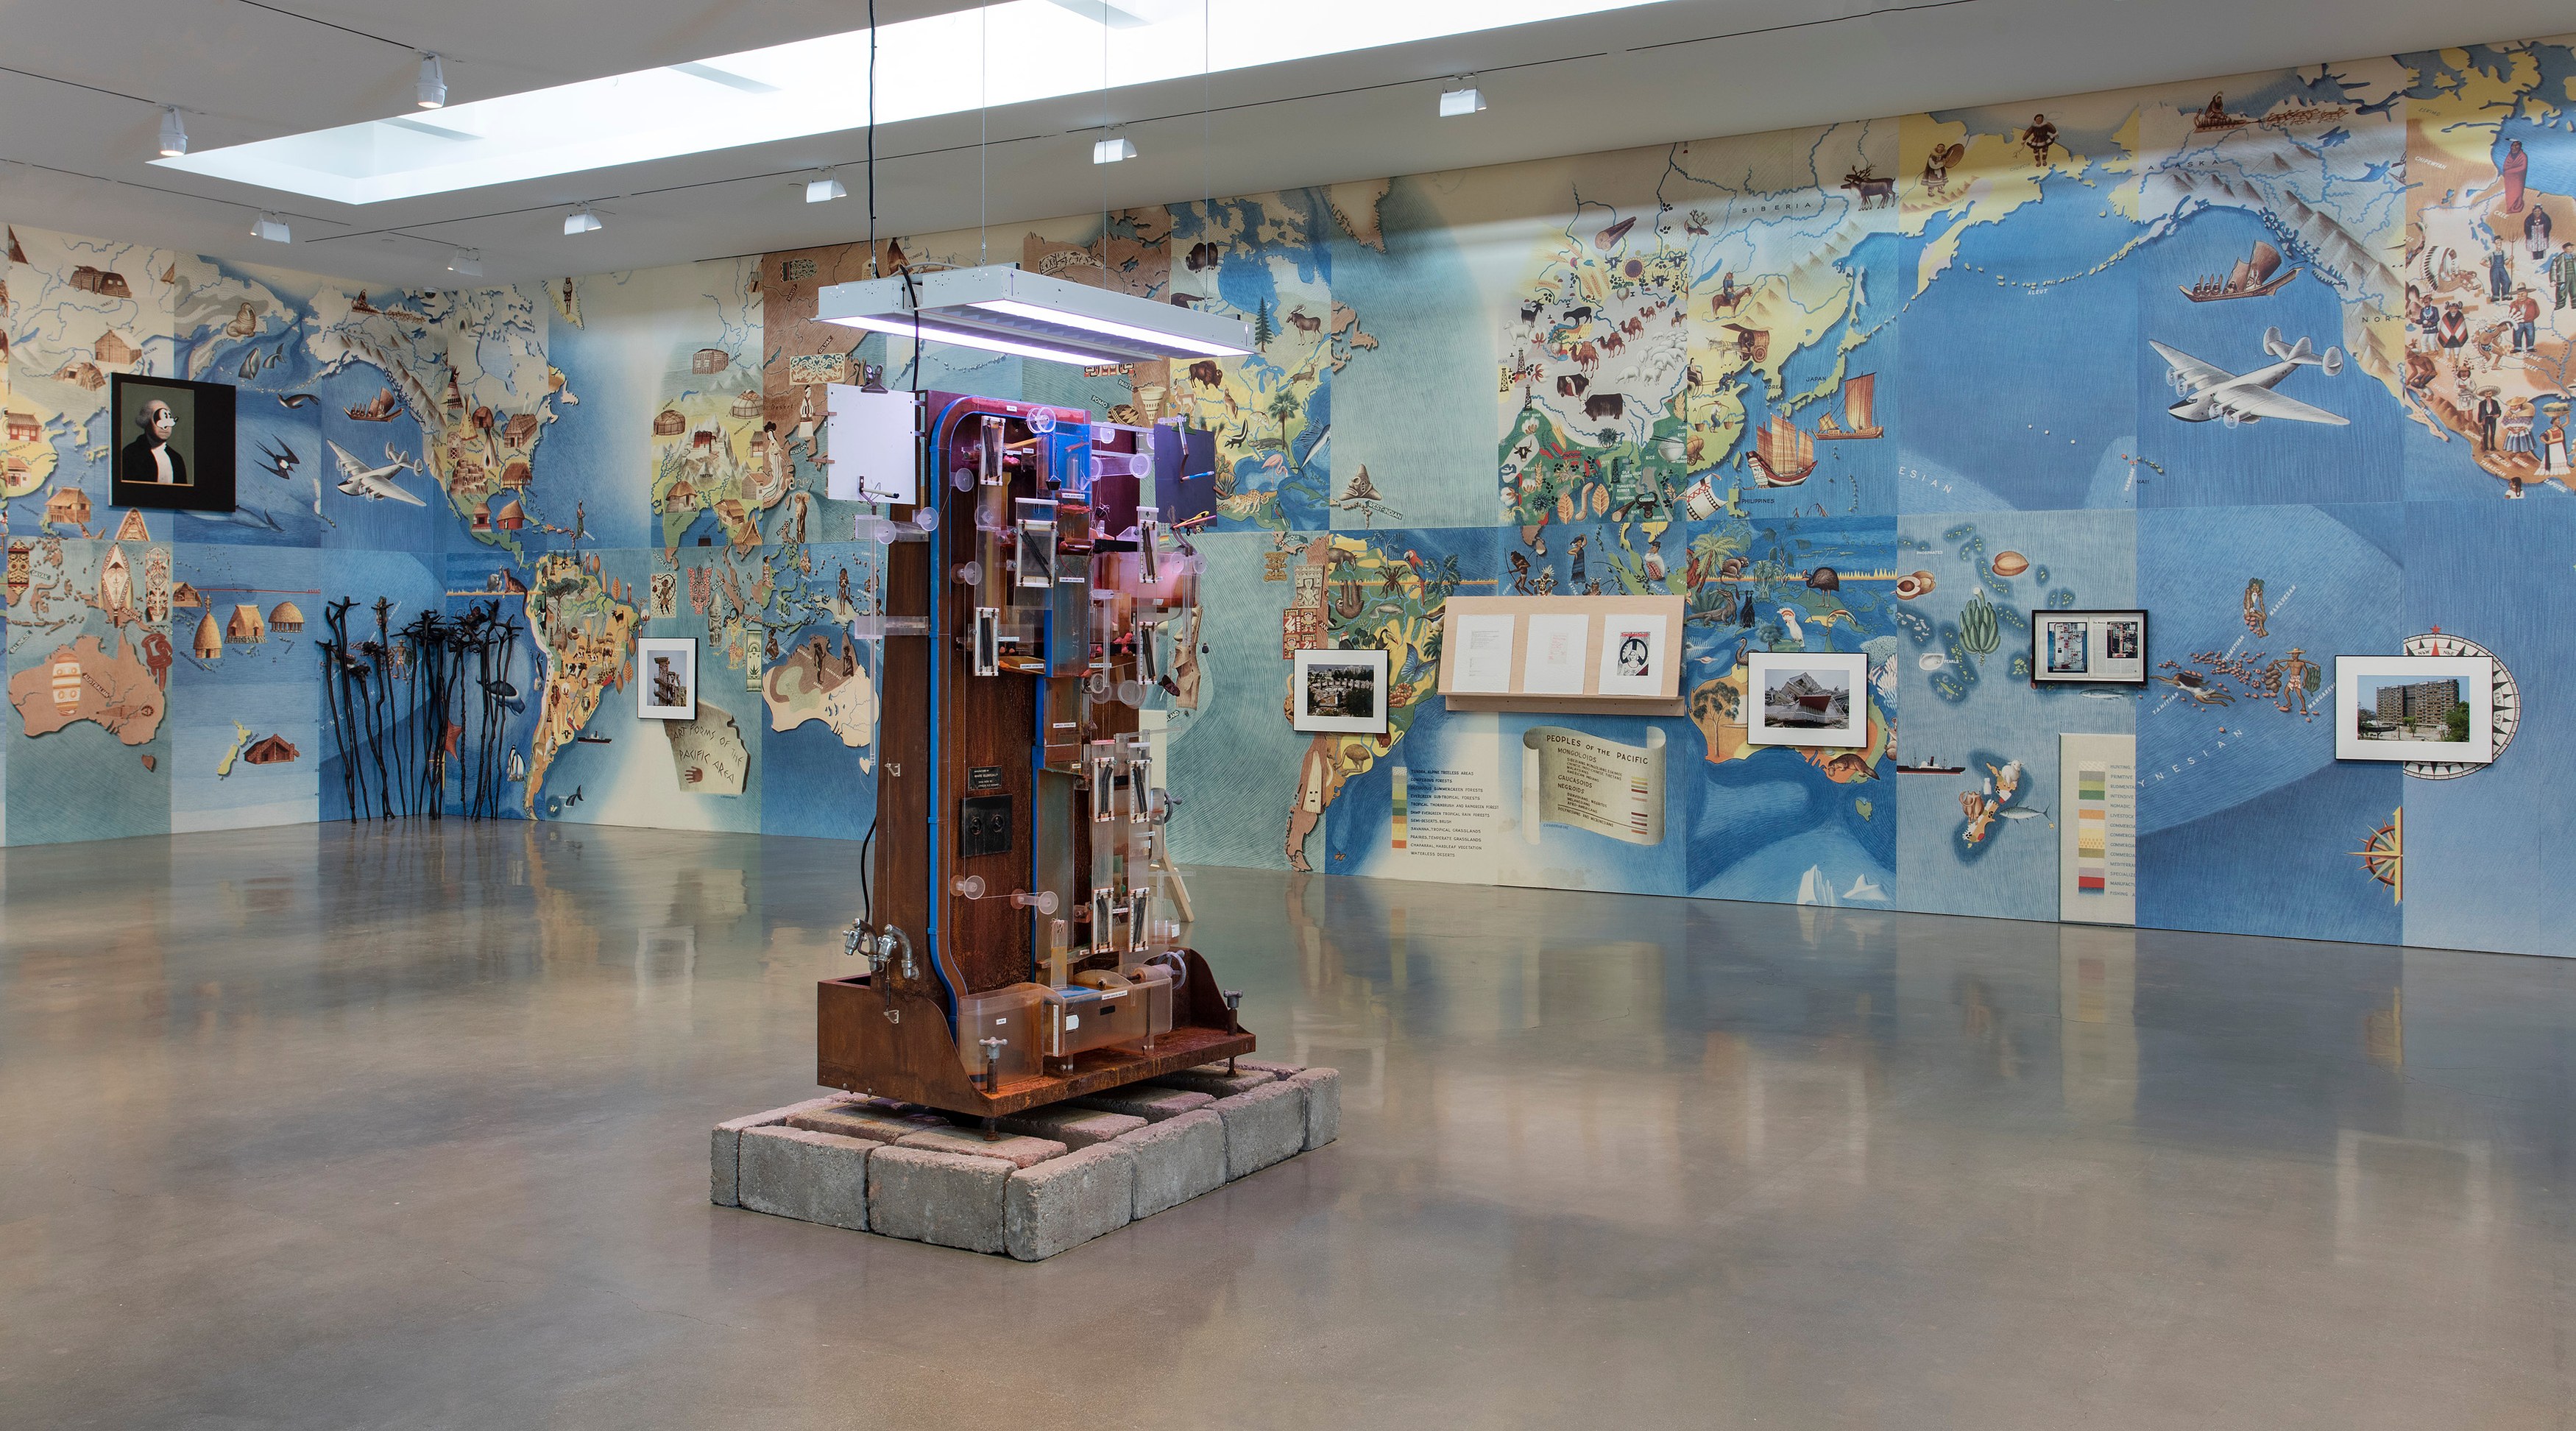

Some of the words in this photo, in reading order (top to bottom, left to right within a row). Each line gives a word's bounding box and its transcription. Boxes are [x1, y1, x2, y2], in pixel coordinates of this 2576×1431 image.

[2148, 160, 2218, 170] ALASKA
[2415, 155, 2447, 171] CHIPEWYAN
[1742, 202, 1811, 213] SIBERIA
[2494, 210, 2509, 220] CREE
[2362, 315, 2402, 323] NORT
[818, 336, 832, 353] GILYAK
[1118, 379, 1135, 392] PAIUTE
[1092, 396, 1108, 408] POMO
[790, 443, 807, 455] KOREAN
[2480, 459, 2507, 477] TARASCAN
[2511, 456, 2530, 468] OTOMI
[1899, 466, 1953, 494] ESIAN
[2544, 478, 2568, 493] ZAPOTEC
[1367, 501, 1403, 520] WEST-INDIAN
[1278, 535, 1301, 548] CHIRIQUI
[1649, 582, 1666, 594] MALAY
[2268, 584, 2297, 618] MARQUESAN
[121, 607, 141, 623] PAPUAN
[10, 631, 32, 654] BALINESE
[2223, 635, 2246, 662] TUAMOTUAN
[796, 648, 813, 660] AUSTRALIAN
[83, 674, 110, 699] AUSTRALIAN
[2152, 691, 2179, 716] TAHITIAN
[673, 726, 687, 742] ART
[690, 723, 716, 741] FORMS
[719, 737, 731, 748] OF
[731, 748, 745, 768] THE
[1546, 735, 1582, 747] PEOPLES
[1597, 748, 1611, 757] THE
[1616, 752, 1649, 765] PACIFIC
[1557, 747, 1597, 763] MONGOLOIDS
[2139, 729, 2243, 789] YNESIAN
[679, 749, 711, 765] PACIFIC
[712, 760, 735, 785] AREA
[1557, 774, 1593, 788] CAUCASOIDS
[1557, 782, 1585, 794] NEGROIDS
